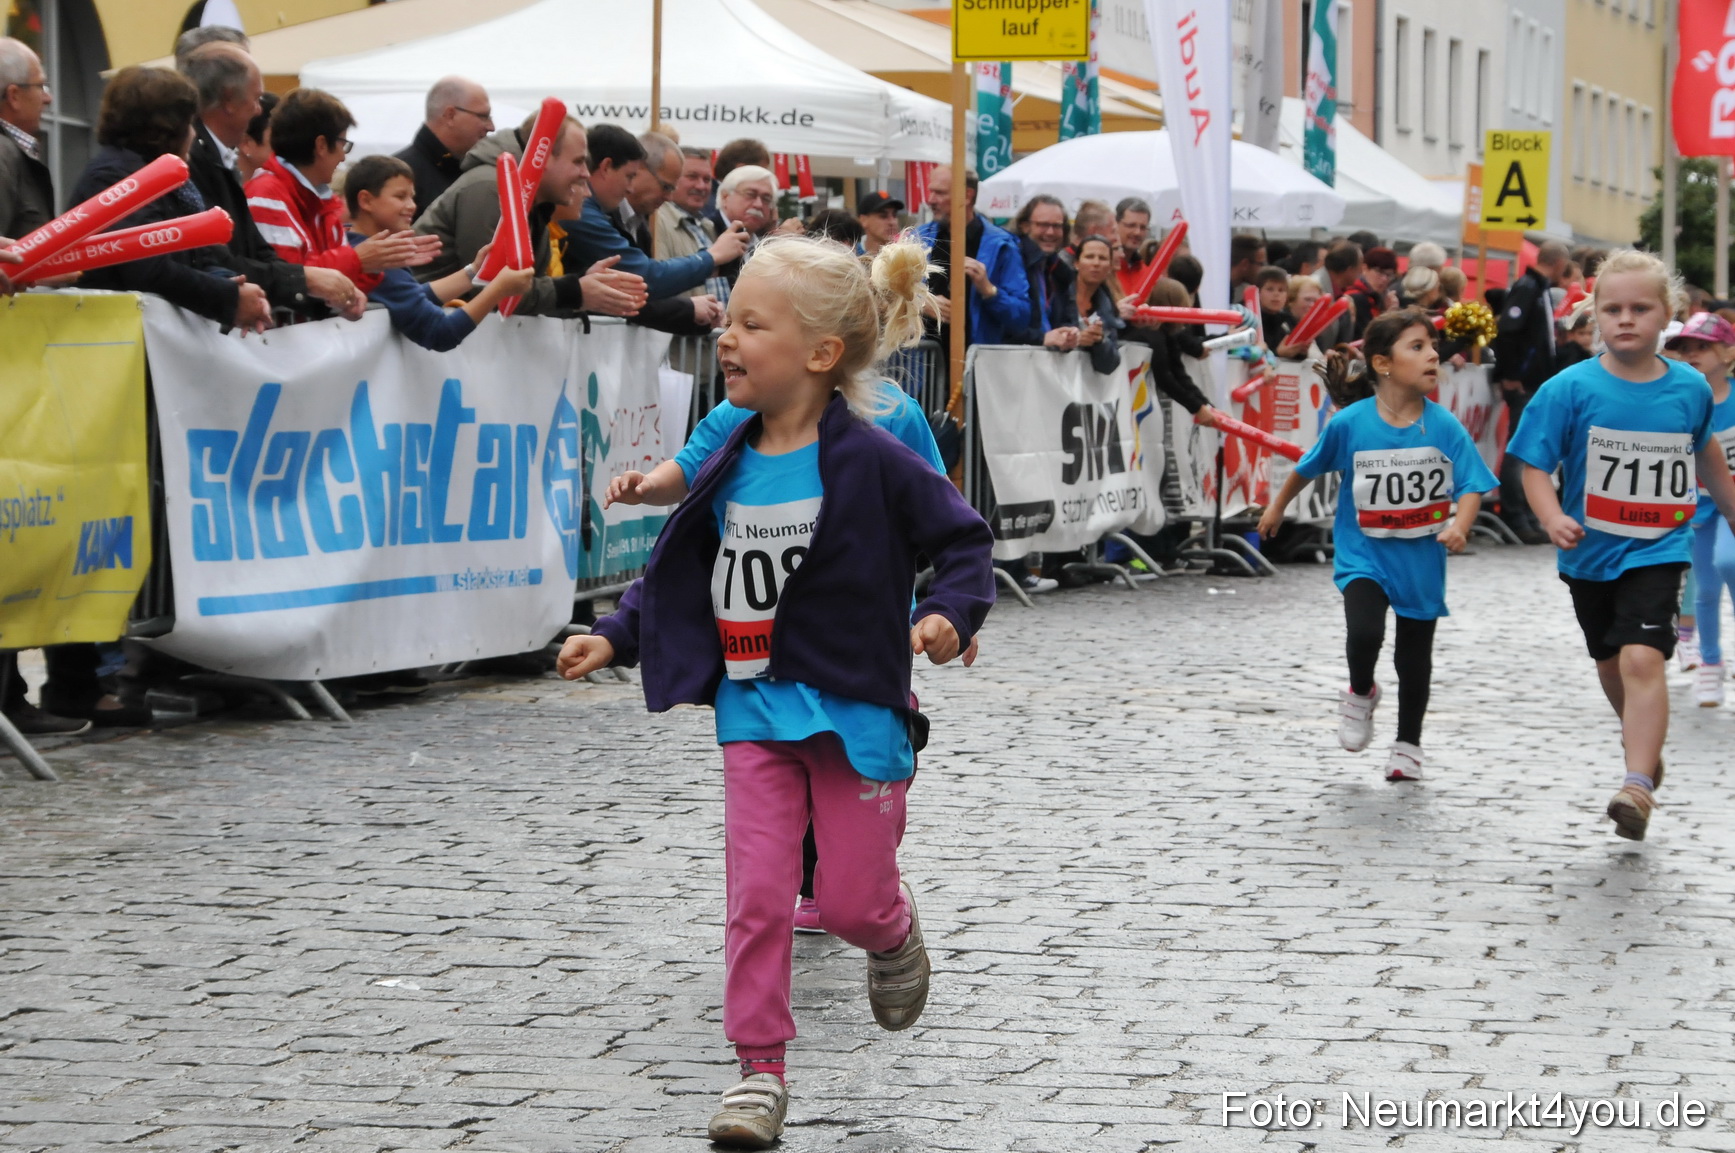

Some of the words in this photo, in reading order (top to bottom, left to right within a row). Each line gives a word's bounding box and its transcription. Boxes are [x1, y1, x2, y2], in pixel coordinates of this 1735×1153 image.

[1002, 17, 1039, 36] lauf
[576, 103, 815, 127] wwwaudibkk.de
[1492, 133, 1542, 151] Block
[1495, 160, 1532, 208] A
[1232, 206, 1260, 221] KK
[11, 230, 51, 255] Audi
[50, 207, 90, 234] BKK
[85, 238, 124, 259] BKK
[1591, 437, 1629, 452] PARTL
[1631, 442, 1682, 454] Neumarkt
[1356, 459, 1387, 469] PARTL
[1390, 456, 1438, 467] Neumarkt
[1365, 468, 1446, 505] 7032
[1600, 455, 1688, 498] 7110
[1381, 512, 1430, 526] Melissa
[1619, 506, 1661, 523] Luisa
[745, 516, 818, 539] Neumar
[722, 629, 773, 654] Jann
